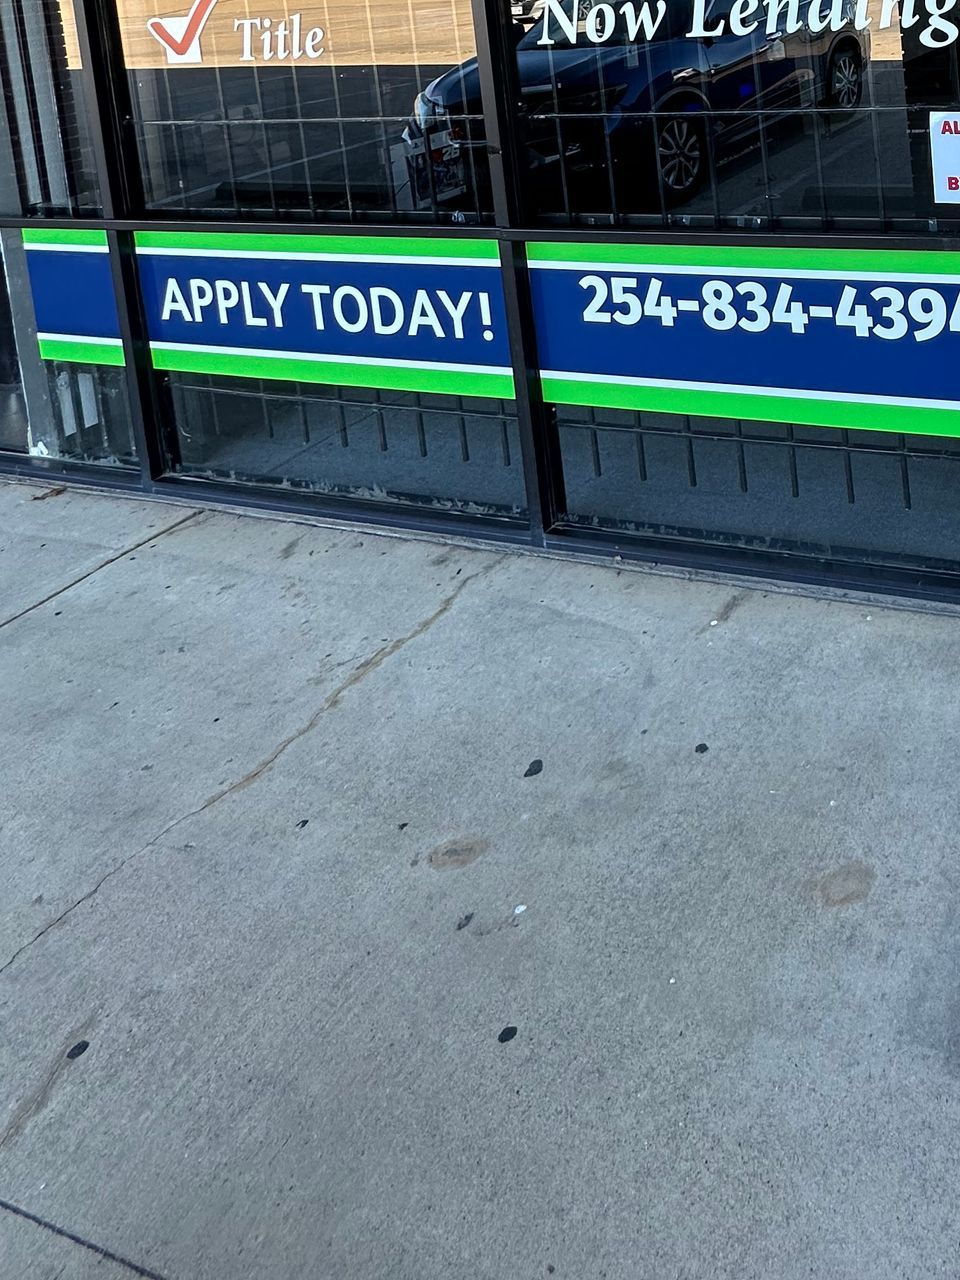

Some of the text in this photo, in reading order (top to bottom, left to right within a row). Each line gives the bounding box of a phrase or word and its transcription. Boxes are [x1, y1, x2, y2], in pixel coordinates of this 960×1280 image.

[233, 12, 325, 62] Title
[161, 277, 494, 342] APPLY TODAY!
